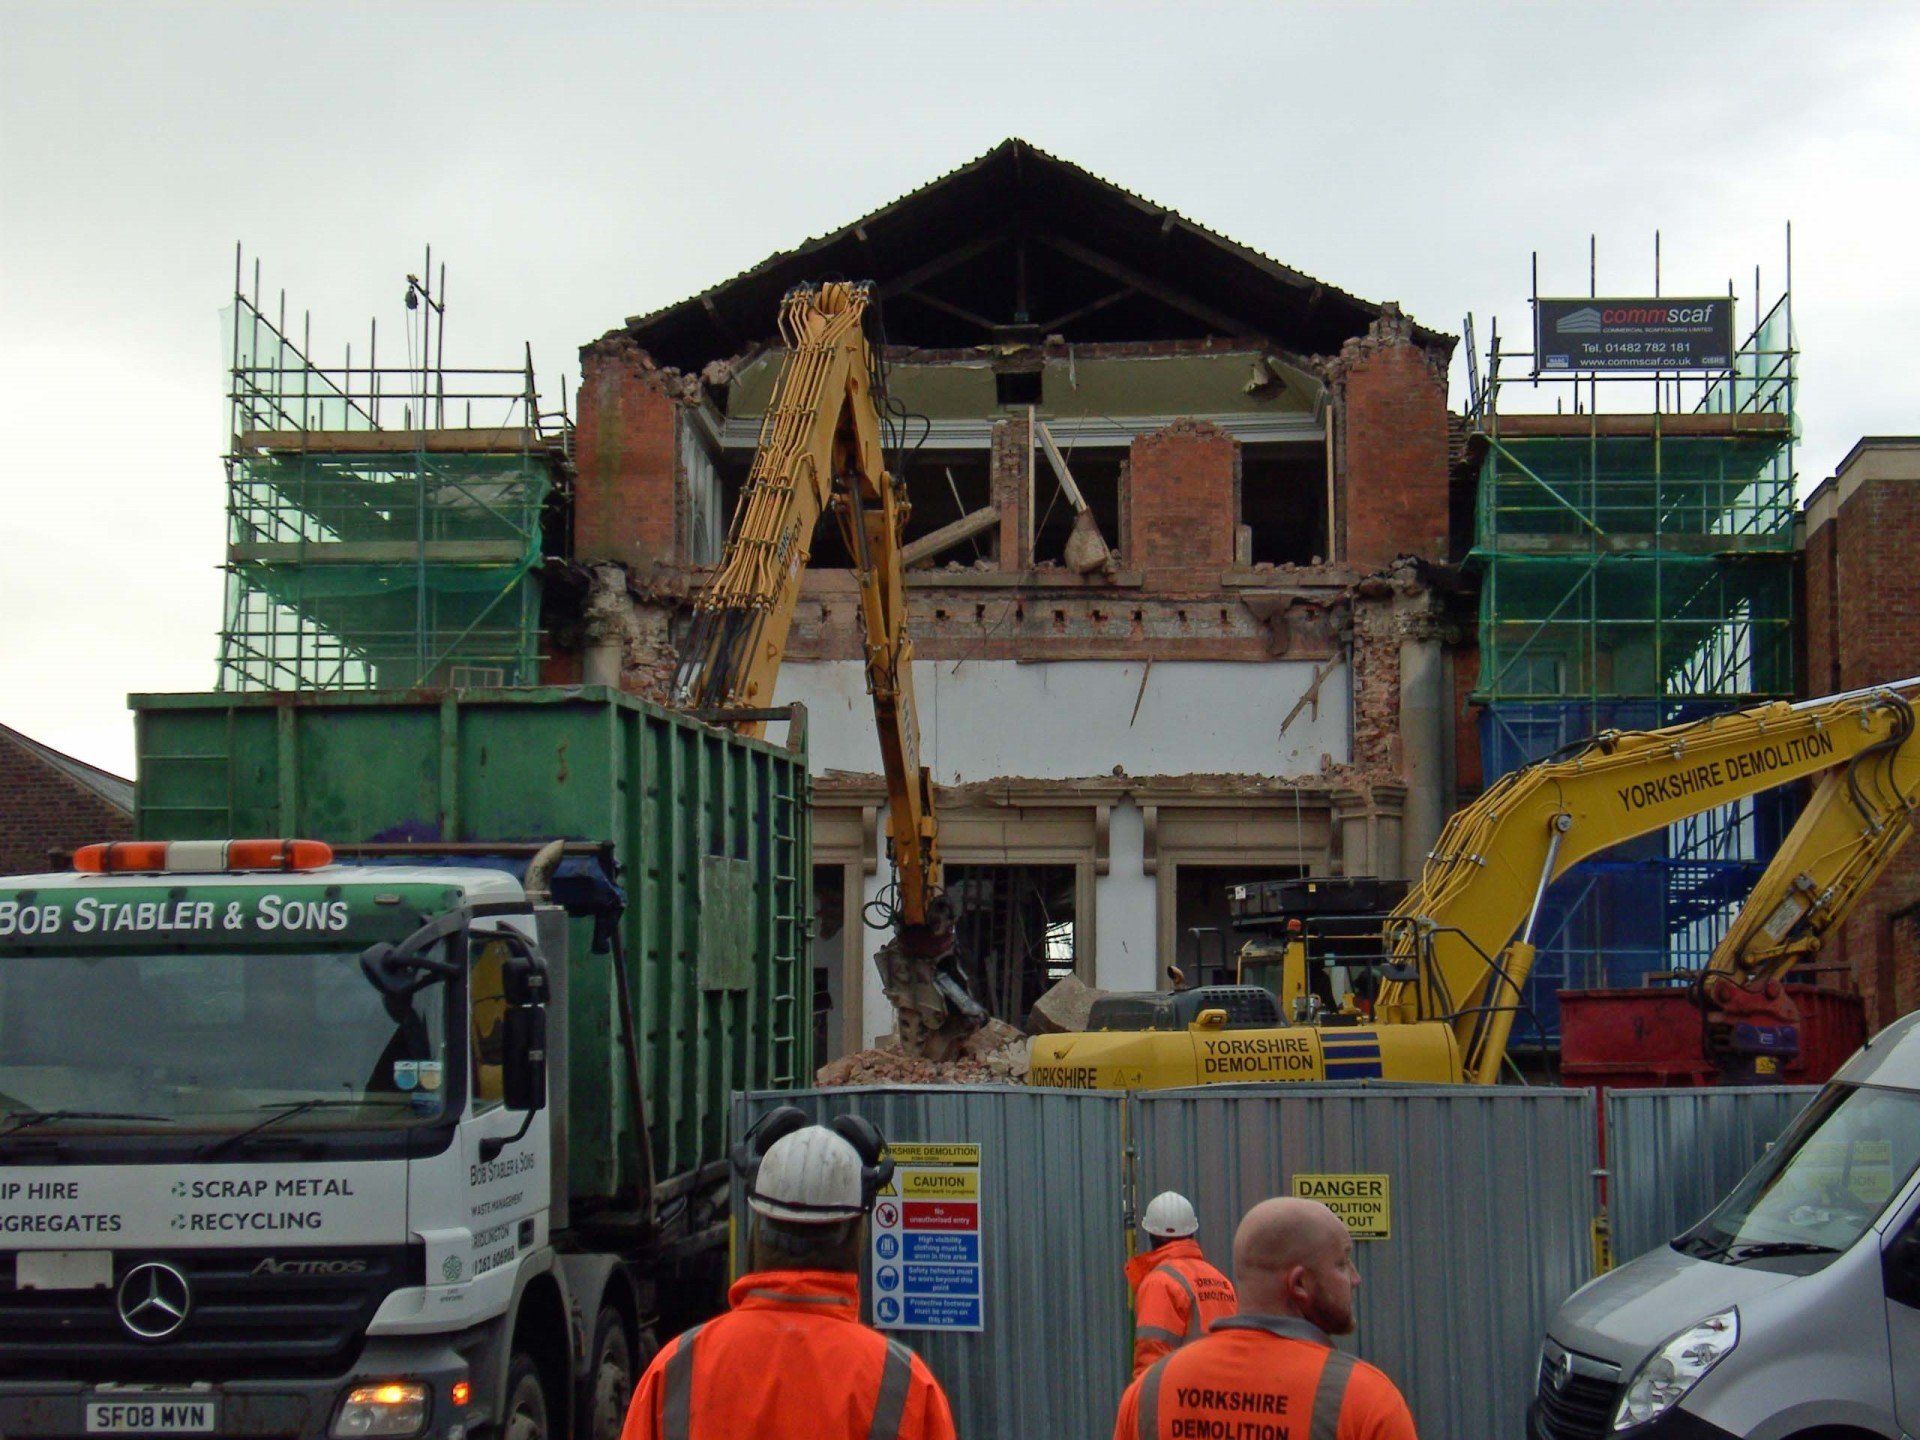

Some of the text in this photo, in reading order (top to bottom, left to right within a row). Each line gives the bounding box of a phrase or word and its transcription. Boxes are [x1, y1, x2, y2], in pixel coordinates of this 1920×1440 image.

[1602, 304, 1714, 324] commscaf
[1605, 343, 1641, 352] 01482
[1645, 343, 1667, 352] 782
[1671, 343, 1691, 352] 181
[1580, 357, 1692, 367] www.commscaf.co.uk
[1618, 730, 1834, 812] YORKSHIRE DEMOLITION
[0, 894, 349, 935] BOB STABLER & SONS
[1206, 1038, 1309, 1055] YORKSHIRE
[1205, 1055, 1314, 1073] DEMOLITION
[1032, 1067, 1097, 1090] YORKSHIRE
[924, 1147, 977, 1156] DEMOLITION
[28, 1183, 78, 1199] HIRE
[192, 1179, 354, 1198] SCRAP METAL
[913, 1177, 965, 1187] CAUTION
[1300, 1181, 1382, 1196] DANGER
[1325, 1202, 1381, 1213] OLITION
[0, 1214, 122, 1232] GREGATES
[190, 1212, 322, 1231] RECYCLING
[1348, 1216, 1374, 1226] OUT
[1177, 1388, 1288, 1415] YORKSHIRE
[97, 1406, 204, 1427] SF08 MVN
[1171, 1419, 1289, 1440] DEMOLITION
